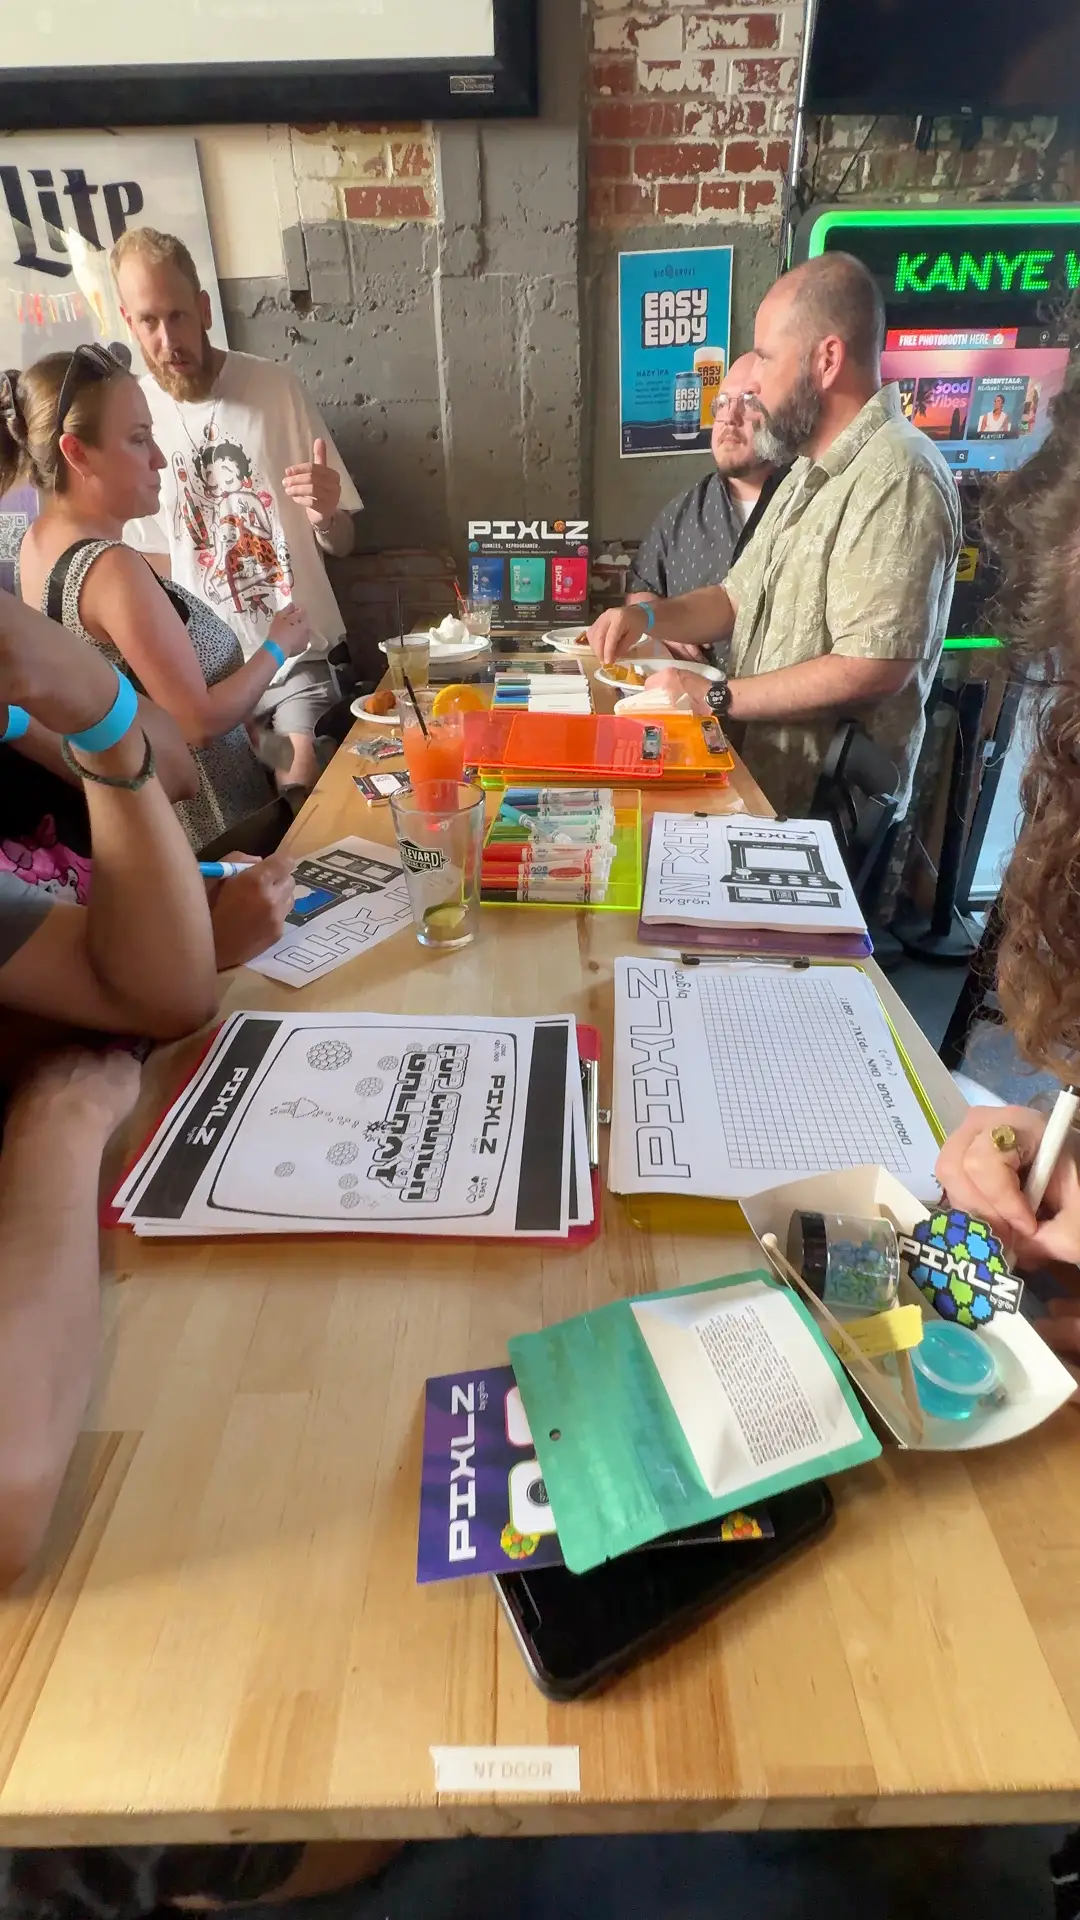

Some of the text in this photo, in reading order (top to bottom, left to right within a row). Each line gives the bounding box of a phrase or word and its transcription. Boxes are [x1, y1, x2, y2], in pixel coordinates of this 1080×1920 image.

[894, 250, 1055, 292] KANYE
[643, 288, 708, 319] EASY
[643, 317, 708, 347] EDDY
[899, 333, 989, 347] FREE PHOTOBOOTH HERE
[636, 368, 669, 377] HAZY IPA
[701, 377, 721, 387] DDY
[675, 388, 700, 400] EASY
[675, 400, 700, 412] EDDY
[468, 520, 589, 540] PIXLZ
[739, 832, 809, 841] PIXLZ
[659, 819, 711, 898] PIXLZ
[659, 897, 674, 905] by
[627, 967, 692, 1179] PIXLZ
[866, 1058, 882, 1077] OWN
[192, 1067, 250, 1146] PIXLZ
[877, 1082, 895, 1109] YOUR
[478, 1075, 506, 1155] PIXLZ
[890, 1115, 913, 1146] DRAW
[900, 1238, 1021, 1303] PIXLZ
[449, 1382, 477, 1563] PIXLZ
[501, 1761, 554, 1779] DOOR
